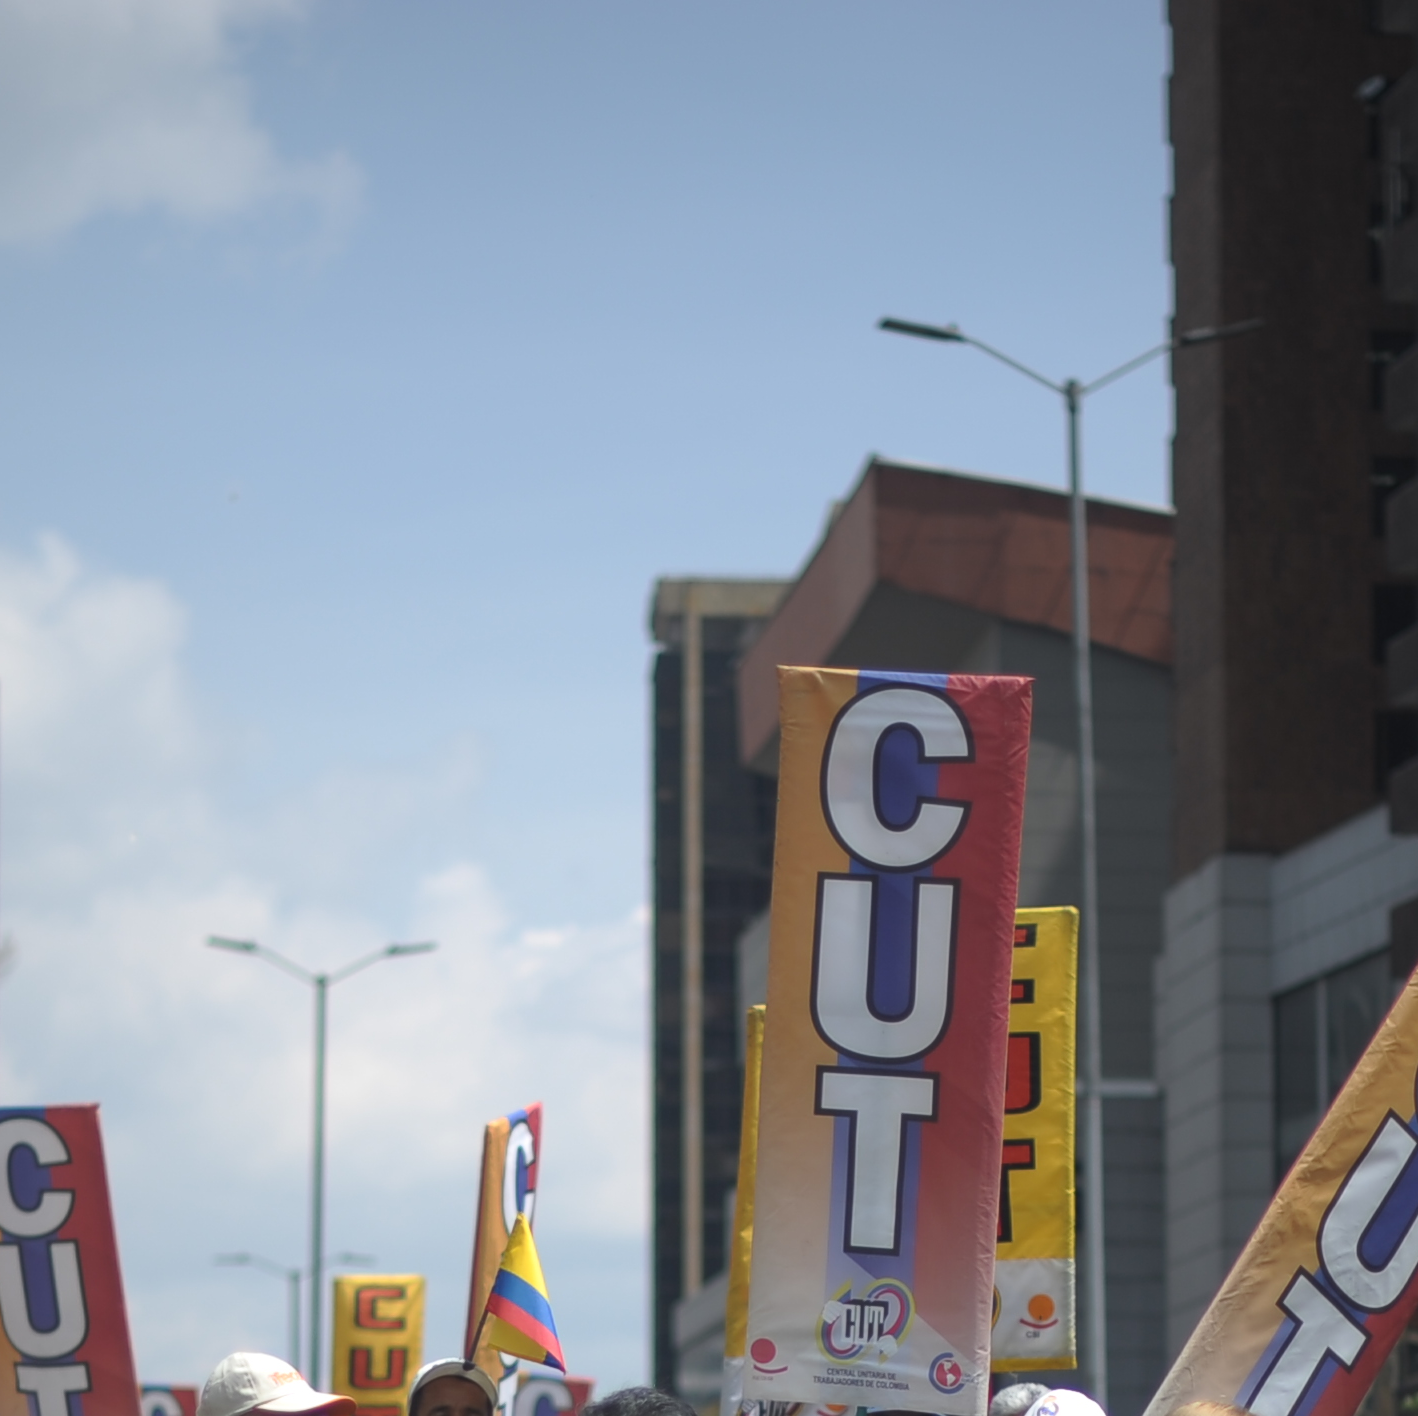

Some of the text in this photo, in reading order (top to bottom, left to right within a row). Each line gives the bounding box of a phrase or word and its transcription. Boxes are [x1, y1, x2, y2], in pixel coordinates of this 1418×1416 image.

[810, 684, 975, 1257] CUT
[826, 1367, 856, 1377] CENTRAL
[887, 1373, 897, 1381] DE
[865, 1380, 875, 1388] DE
